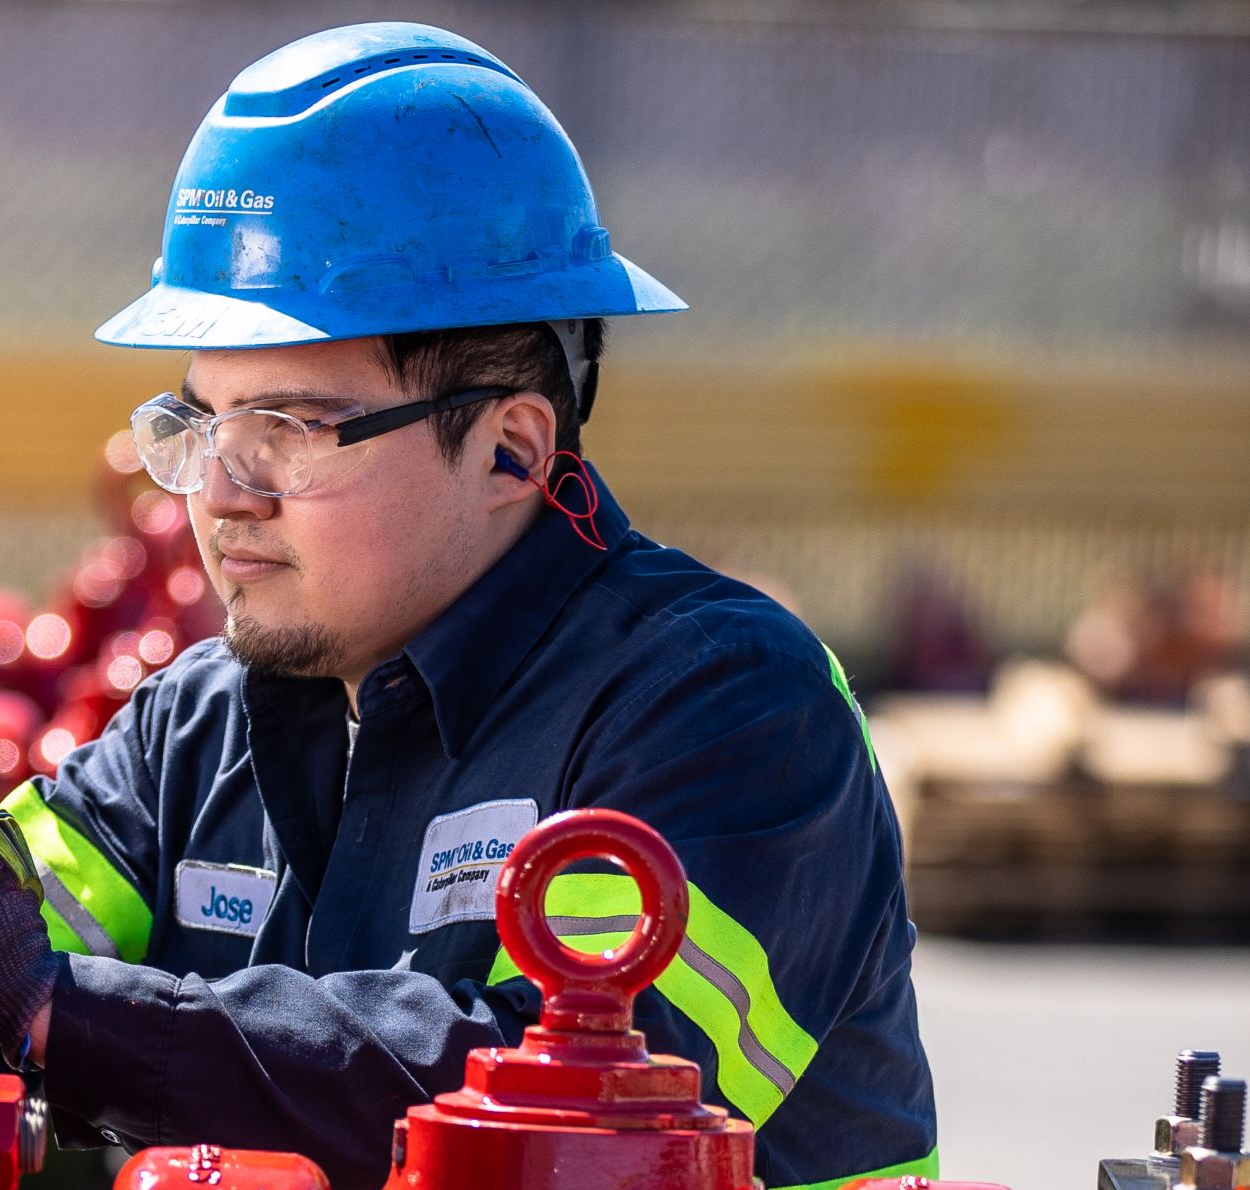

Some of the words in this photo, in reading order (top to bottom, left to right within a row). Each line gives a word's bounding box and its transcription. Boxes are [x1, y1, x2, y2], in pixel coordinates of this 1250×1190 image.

[204, 189, 225, 208] Oil
[225, 189, 238, 208] &
[240, 189, 275, 209] Gas
[456, 842, 473, 864] Oil
[472, 840, 484, 861] &
[485, 838, 515, 860] Gas
[458, 868, 490, 883] Company
[201, 886, 253, 924] Jose
